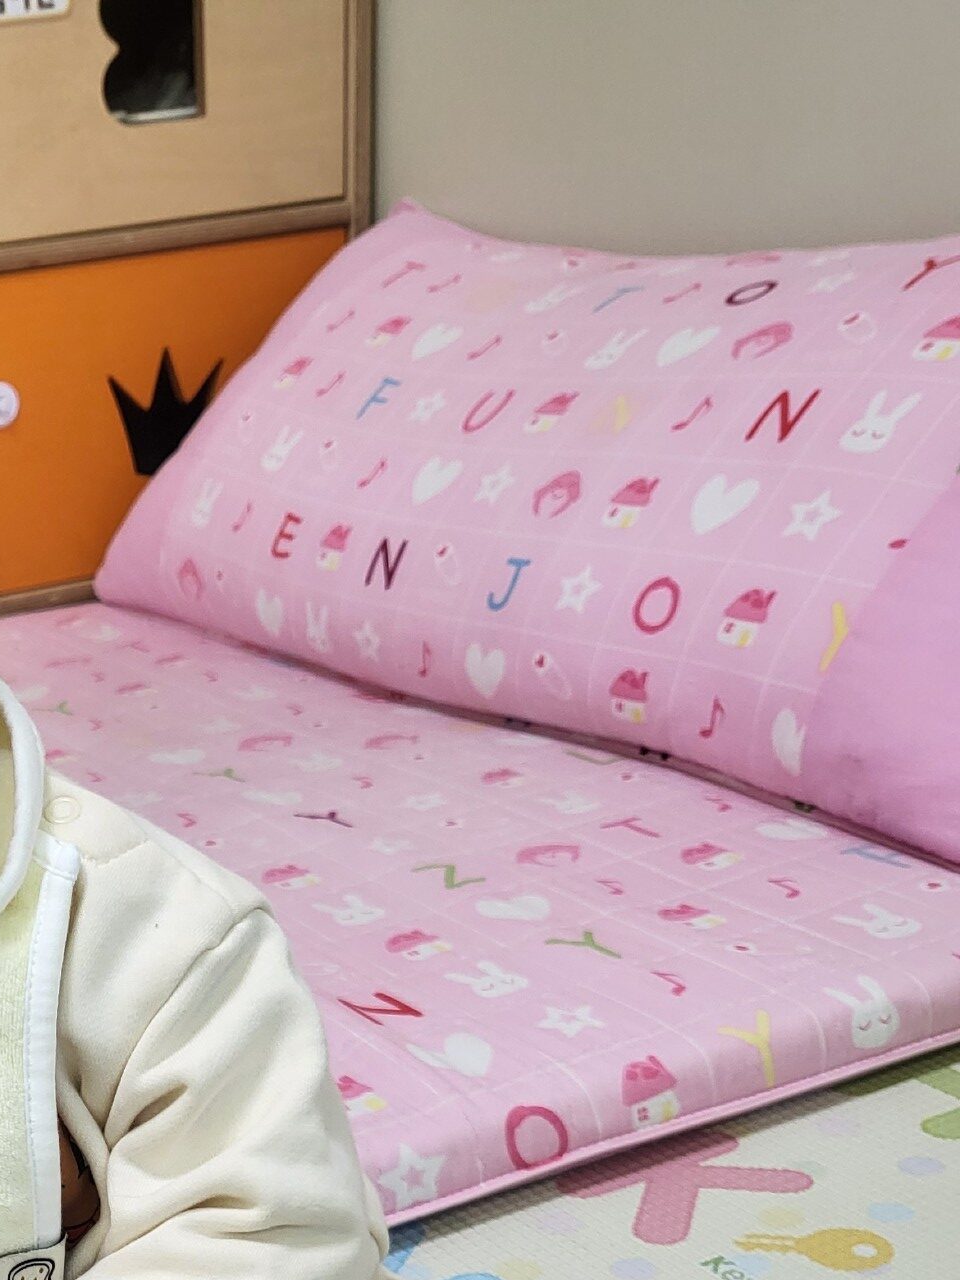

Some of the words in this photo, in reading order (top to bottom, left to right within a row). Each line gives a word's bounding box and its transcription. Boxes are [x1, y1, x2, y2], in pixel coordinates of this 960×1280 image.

[356, 377, 401, 419] F
[462, 389, 516, 434] U
[746, 388, 821, 443] N
[271, 512, 303, 558] E
[364, 536, 408, 590] N
[487, 557, 532, 611] J
[632, 576, 681, 635] O
